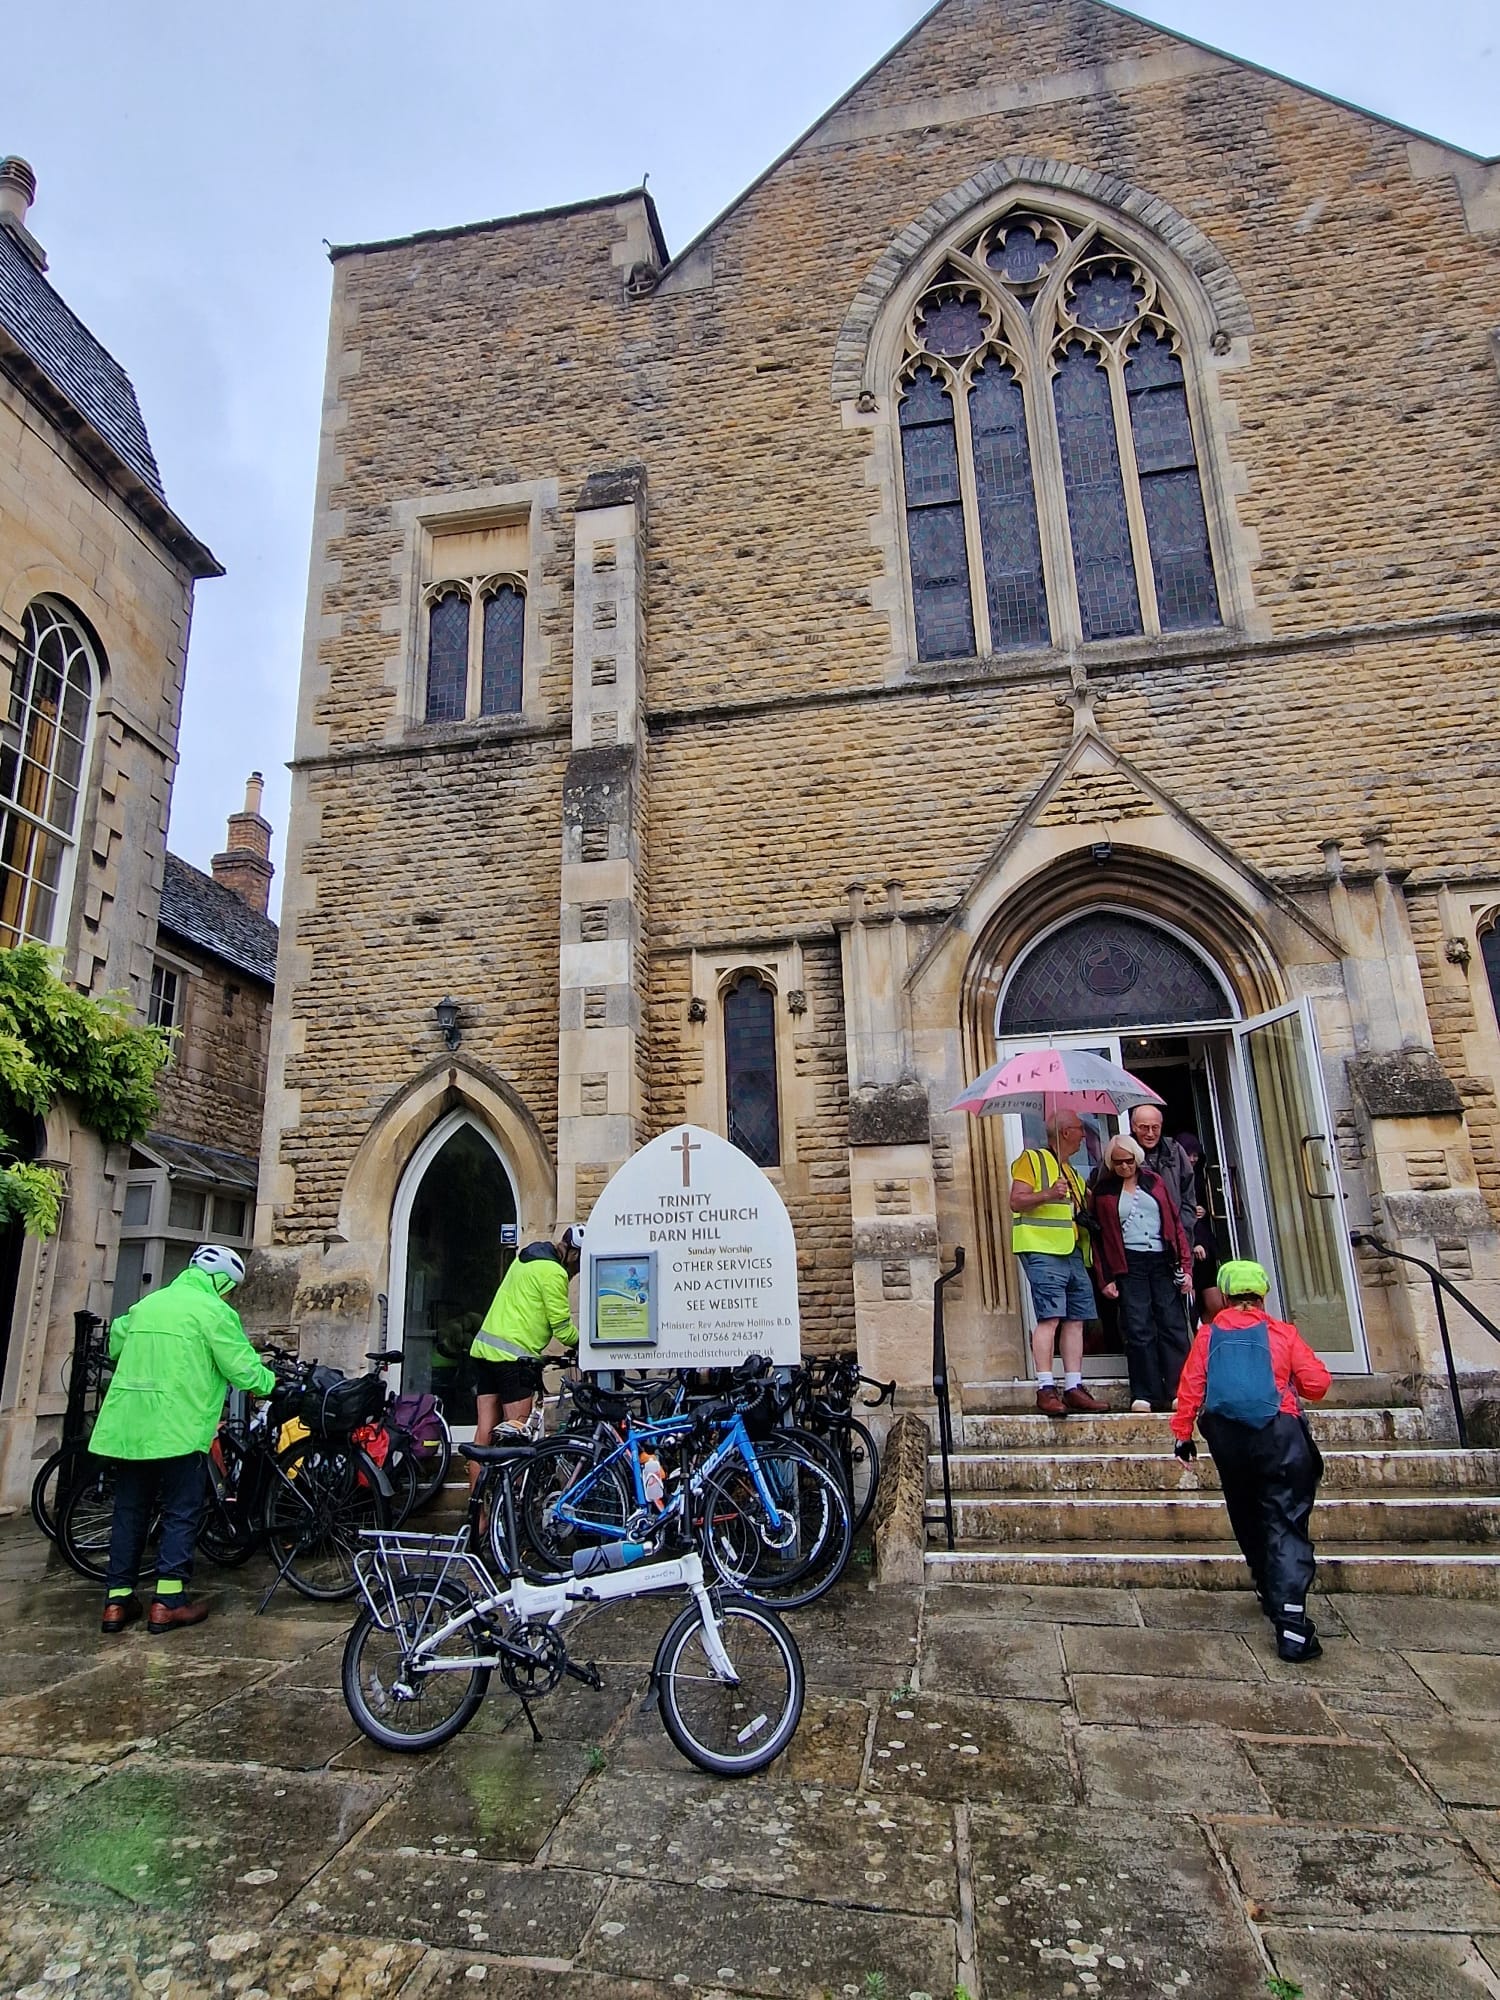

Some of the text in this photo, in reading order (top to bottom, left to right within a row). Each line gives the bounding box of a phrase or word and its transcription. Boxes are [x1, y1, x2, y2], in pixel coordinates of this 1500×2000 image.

[658, 1193, 711, 1208] TRINITY
[614, 1207, 758, 1226] METHODIST CHURCH
[649, 1227, 721, 1242] BARN HILL
[687, 1245, 753, 1256] Sunday Worship
[672, 1258, 773, 1273] OTHER SERVICES
[673, 1277, 773, 1292] AND ACTIVITIES
[686, 1297, 758, 1311] SEE WEBSITE
[661, 1321, 695, 1330] Minister:
[698, 1320, 712, 1329] Rev
[715, 1320, 745, 1328] Andrew
[689, 1331, 764, 1342] Tel 07566 246347
